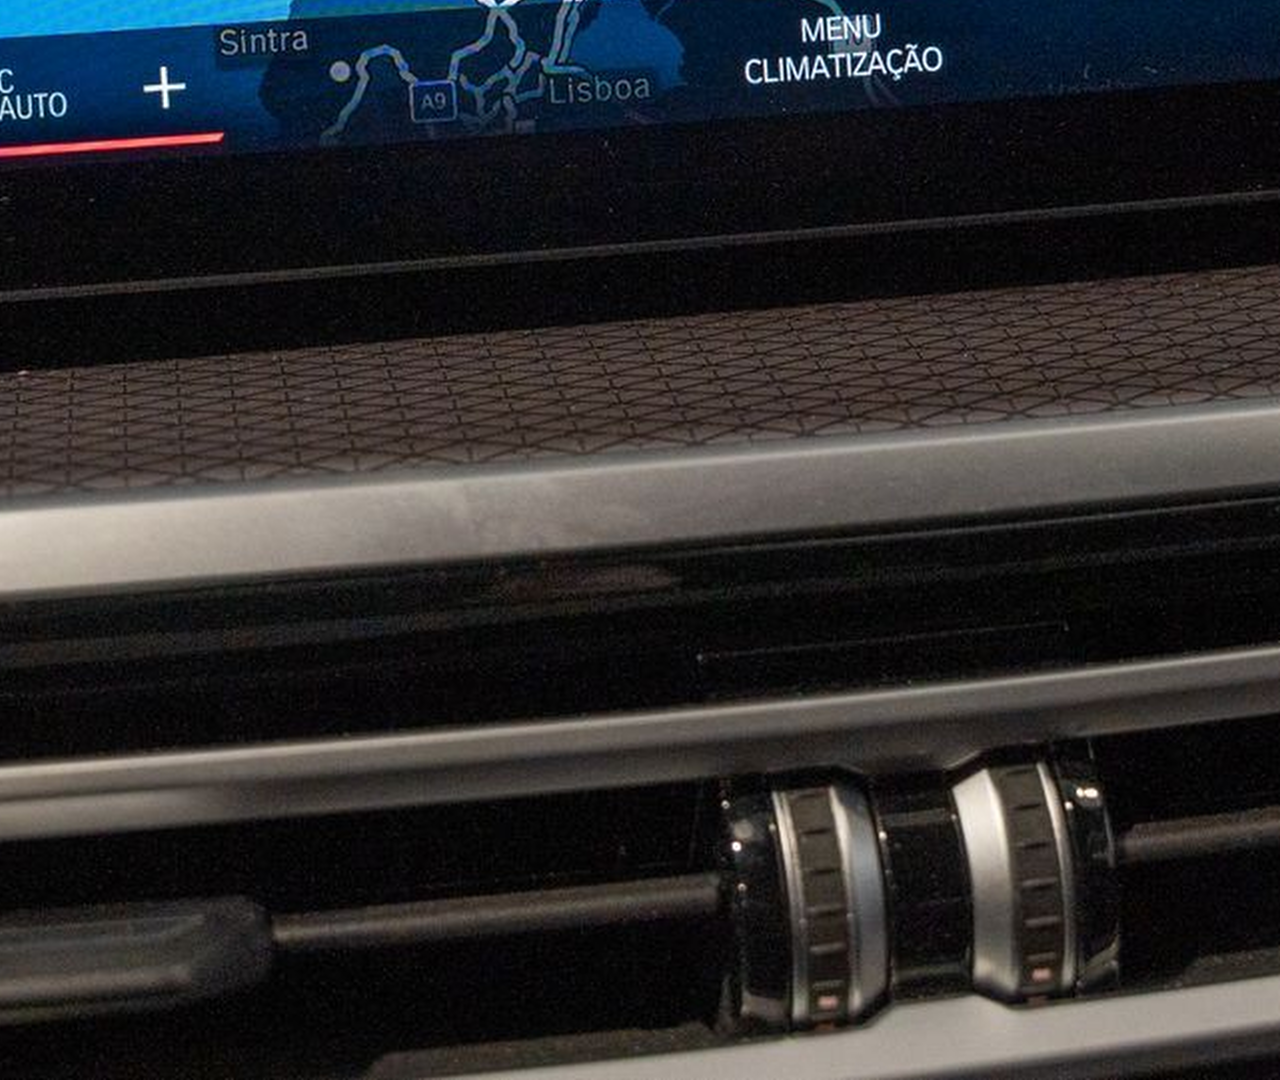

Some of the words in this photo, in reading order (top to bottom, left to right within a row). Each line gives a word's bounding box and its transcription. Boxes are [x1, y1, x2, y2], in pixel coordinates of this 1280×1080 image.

[220, 28, 309, 55] Sintra
[801, 13, 882, 43] MENU
[744, 45, 943, 82] CLIMATIZAÇÃO
[421, 93, 447, 110] A9
[550, 75, 650, 104] Lisboa
